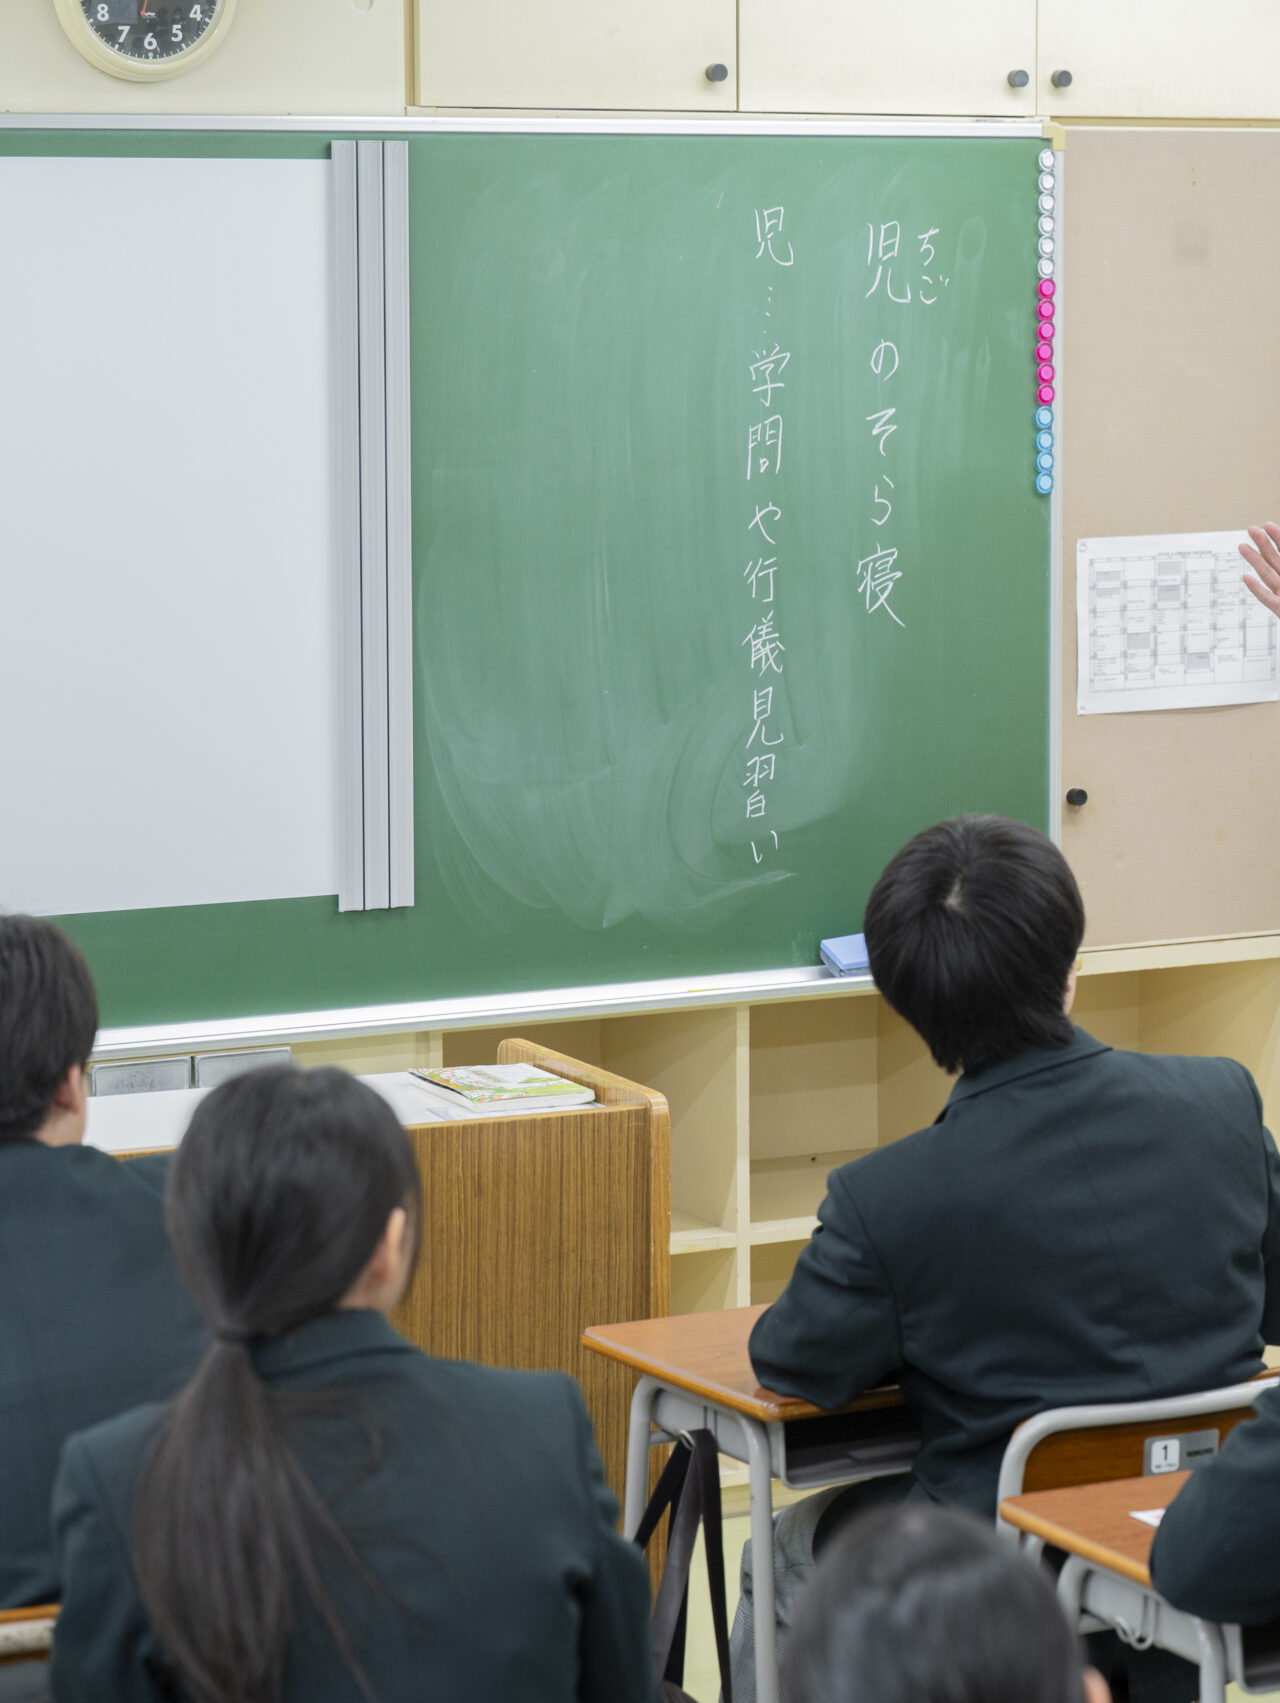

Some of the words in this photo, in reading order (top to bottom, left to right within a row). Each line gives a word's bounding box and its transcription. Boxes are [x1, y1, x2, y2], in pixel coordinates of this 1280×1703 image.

[97, 3, 110, 22] 8
[189, 4, 203, 21] 4
[118, 25, 131, 43] 7
[143, 32, 158, 50] 6
[171, 24, 184, 42] 5
[917, 226, 950, 304] ちご
[856, 220, 911, 628] 児のそら寝
[1162, 1444, 1169, 1462] 1
